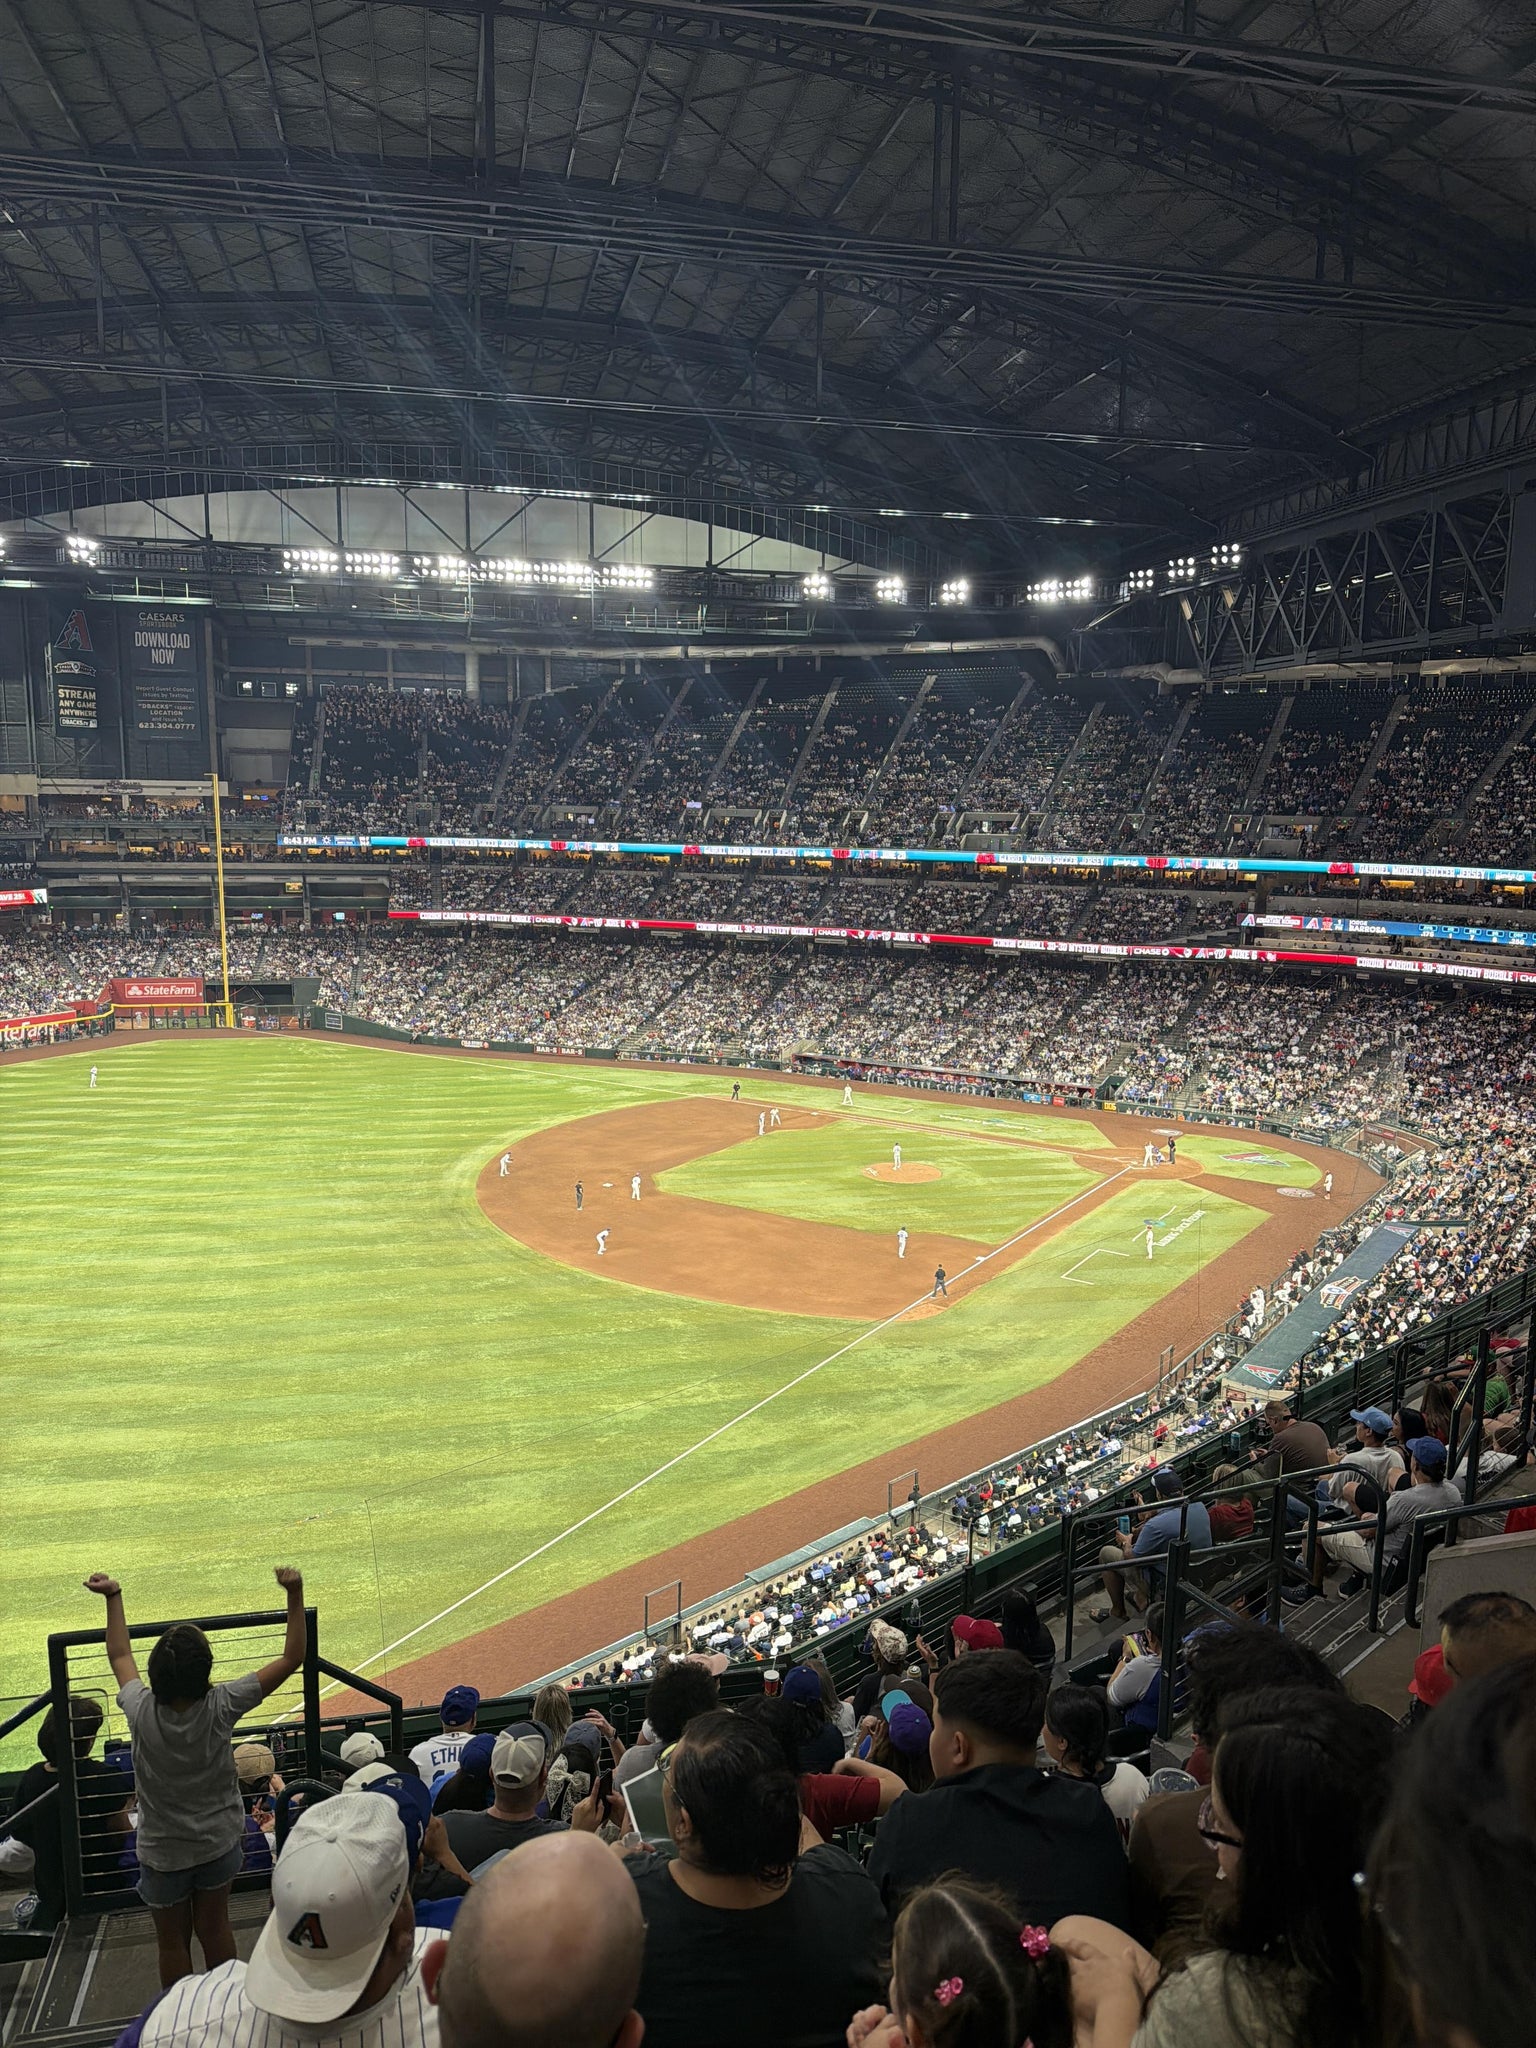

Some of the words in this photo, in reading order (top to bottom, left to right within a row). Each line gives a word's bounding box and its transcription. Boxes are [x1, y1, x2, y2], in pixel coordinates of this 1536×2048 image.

[138, 612, 185, 622] CAESARS
[134, 631, 190, 648] DOWNLOAD
[151, 648, 175, 664] NOW
[58, 688, 96, 701] STREAM
[77, 701, 97, 709] GAME
[59, 708, 97, 717] ANYWHERE
[138, 722, 195, 730] 623.304.0777
[283, 836, 302, 845] 8:43
[303, 837, 317, 846] PM
[1227, 860, 1239, 870] 20
[1391, 866, 1423, 877] MORENO
[1425, 867, 1454, 878] SOCCER
[1456, 868, 1485, 879] JERSEY
[1350, 926, 1386, 934] BARROSA
[1421, 962, 1446, 973] 30-30
[1447, 965, 1481, 978] MYSTERY
